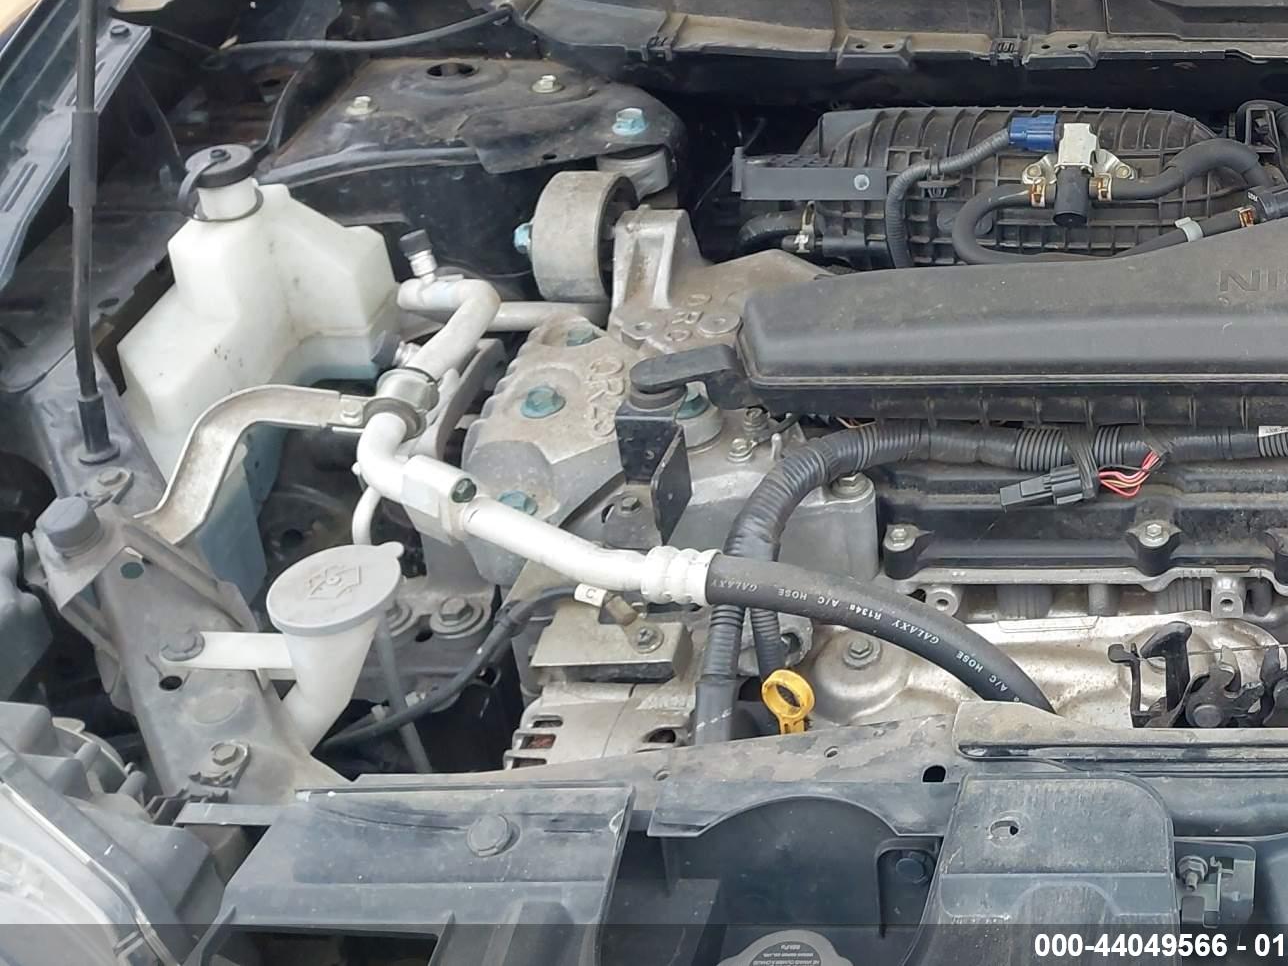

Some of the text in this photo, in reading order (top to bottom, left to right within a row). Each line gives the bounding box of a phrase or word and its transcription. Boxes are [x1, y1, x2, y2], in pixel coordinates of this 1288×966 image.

[710, 579, 758, 593] GALAXY
[585, 588, 597, 599] C
[777, 588, 808, 601] HOSE
[817, 595, 840, 608] A/C
[891, 619, 940, 644] GALAXY
[956, 650, 984, 674] HOSE
[988, 674, 1009, 692] A/C
